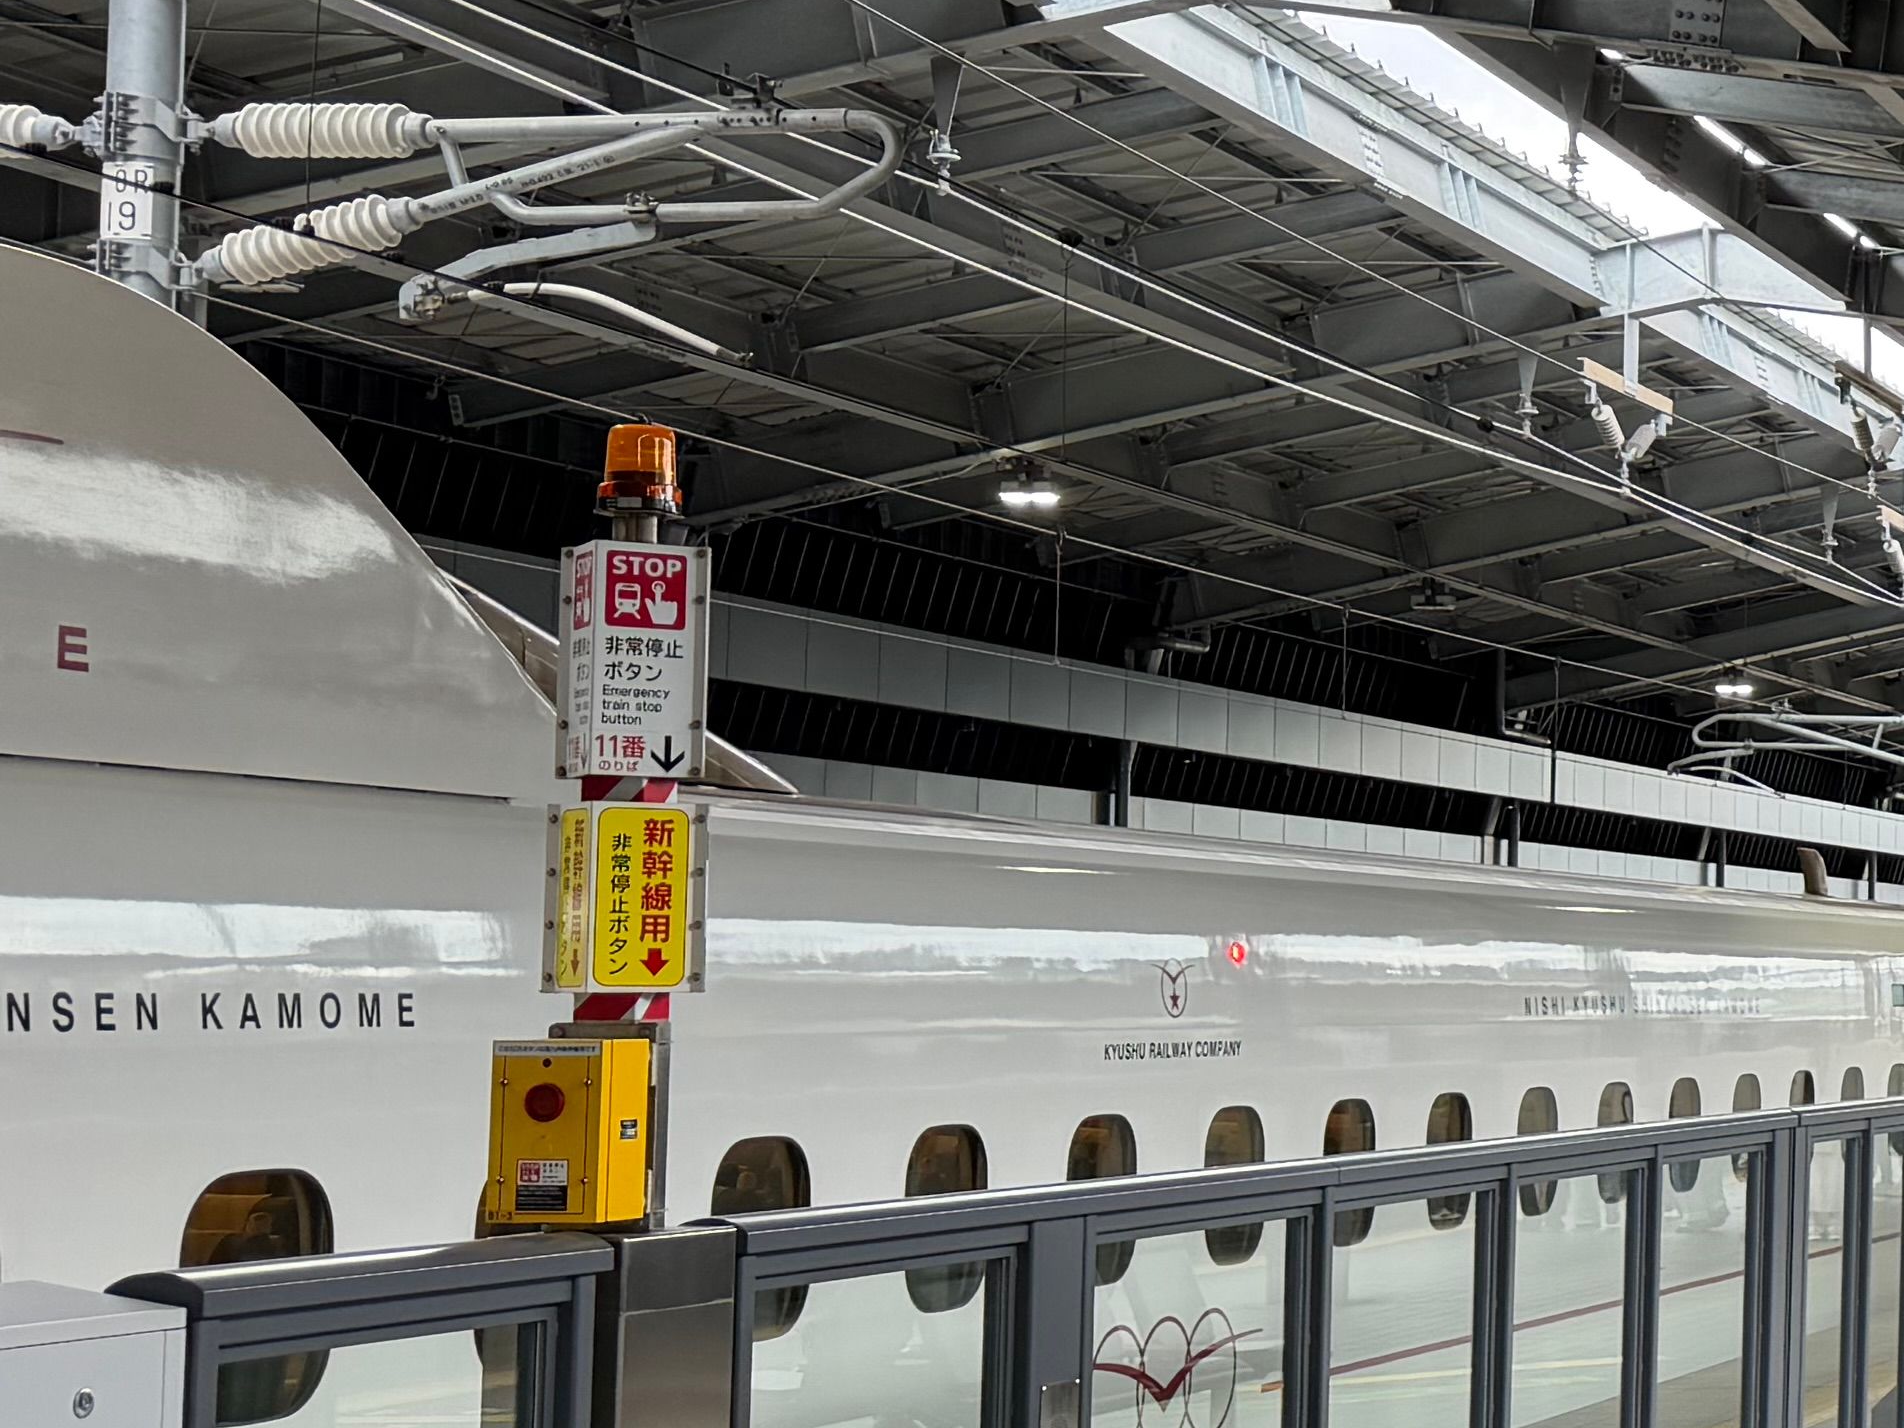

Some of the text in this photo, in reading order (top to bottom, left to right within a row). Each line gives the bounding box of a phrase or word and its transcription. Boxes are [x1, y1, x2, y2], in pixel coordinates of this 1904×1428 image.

[107, 201, 136, 232] 19
[612, 555, 682, 578] STOP
[604, 635, 684, 659] 非常停止
[603, 662, 663, 682] ボタン
[602, 684, 671, 701] Emergency
[601, 699, 663, 714] train stop
[601, 712, 642, 726] button
[595, 734, 646, 760] 11番
[598, 760, 640, 773] のりば
[639, 817, 676, 944] 新幹線用
[609, 833, 633, 976] 非常停止ボタン
[7, 991, 416, 1033] NSEN KAMOME
[1524, 996, 1567, 1017] NISHI
[1104, 1039, 1242, 1061] KYUSHU RAILWAY COMPANY
